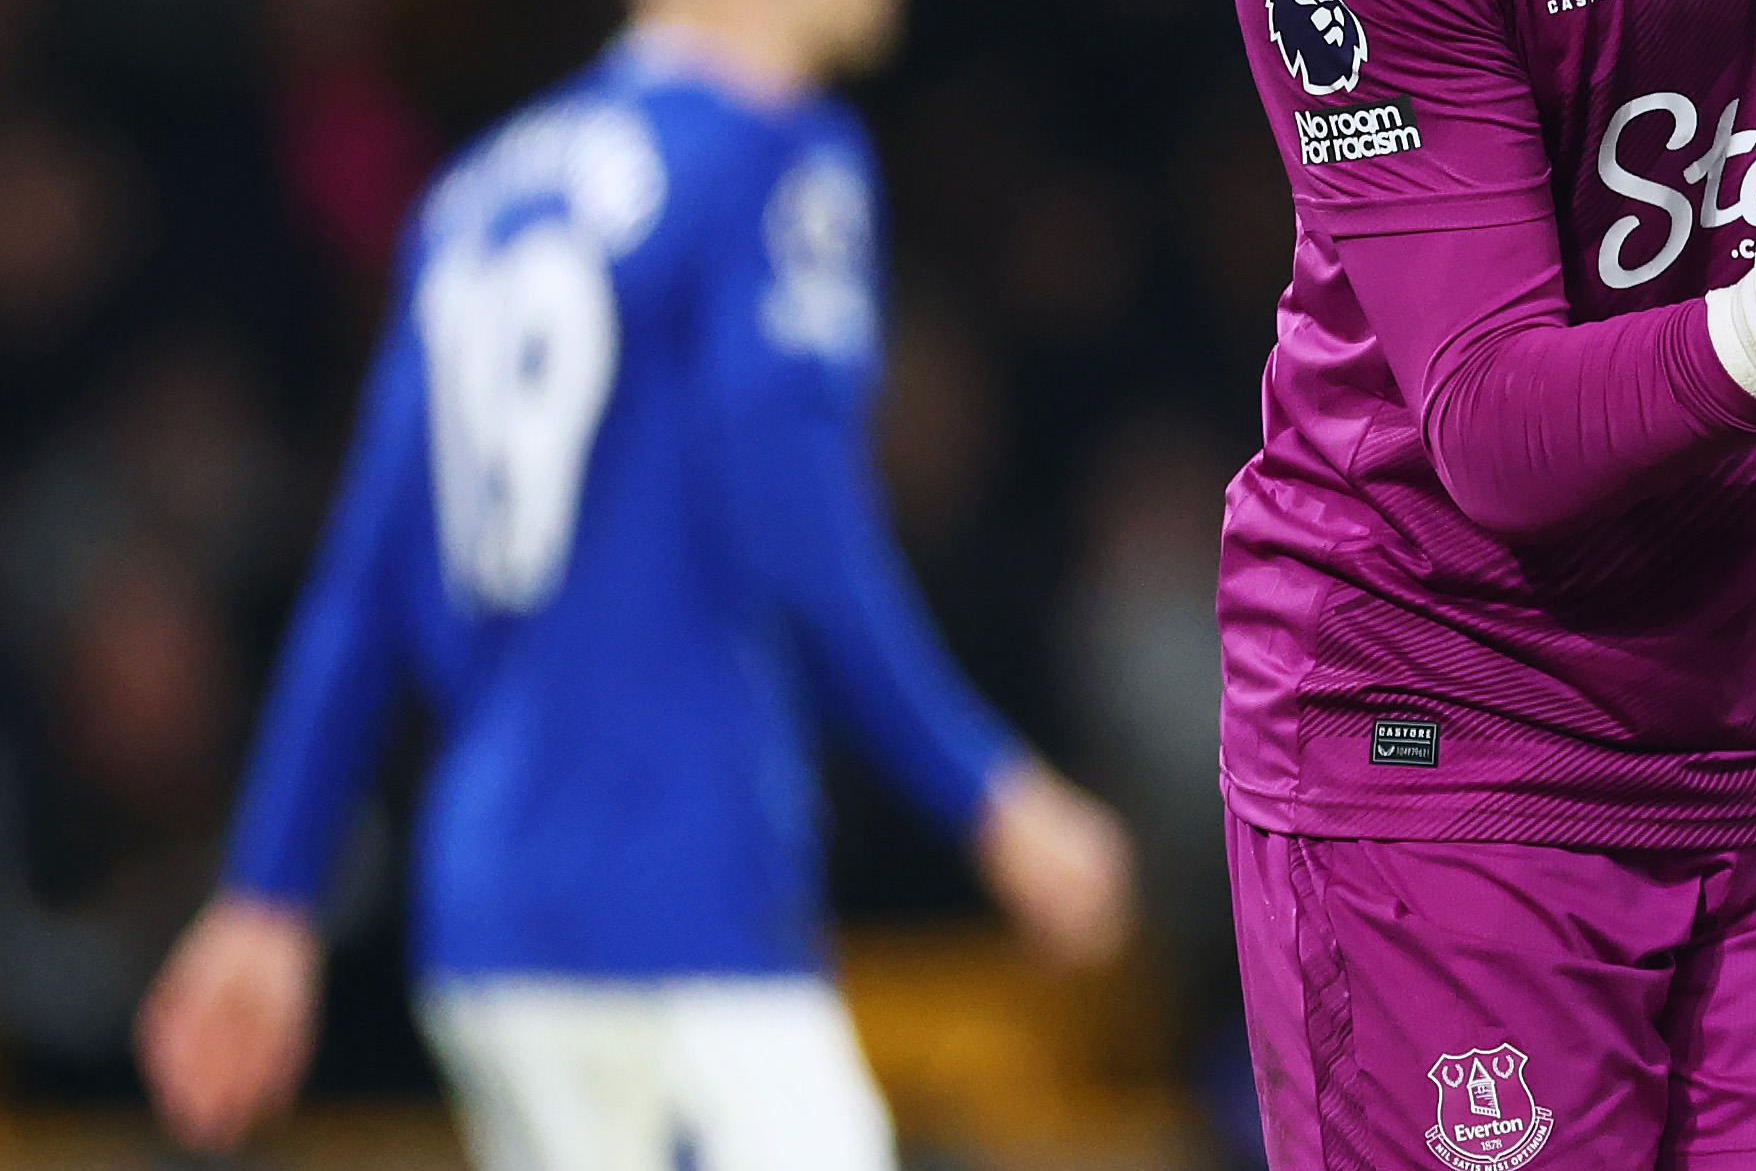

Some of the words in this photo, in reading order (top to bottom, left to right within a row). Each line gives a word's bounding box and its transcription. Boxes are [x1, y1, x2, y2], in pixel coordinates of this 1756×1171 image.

[1294, 110, 1328, 139] No
[1329, 105, 1402, 137] room
[1333, 126, 1422, 161] racism
[1378, 726, 1431, 738] CASTORE
[1454, 1118, 1524, 1142] Everton
[1435, 1143, 1450, 1161] NIL
[1452, 1157, 1481, 1171] SATIS
[1485, 1160, 1509, 1171] NISI
[1511, 1125, 1548, 1166] OPTIMUM
[1480, 1139, 1502, 1151] 1878
